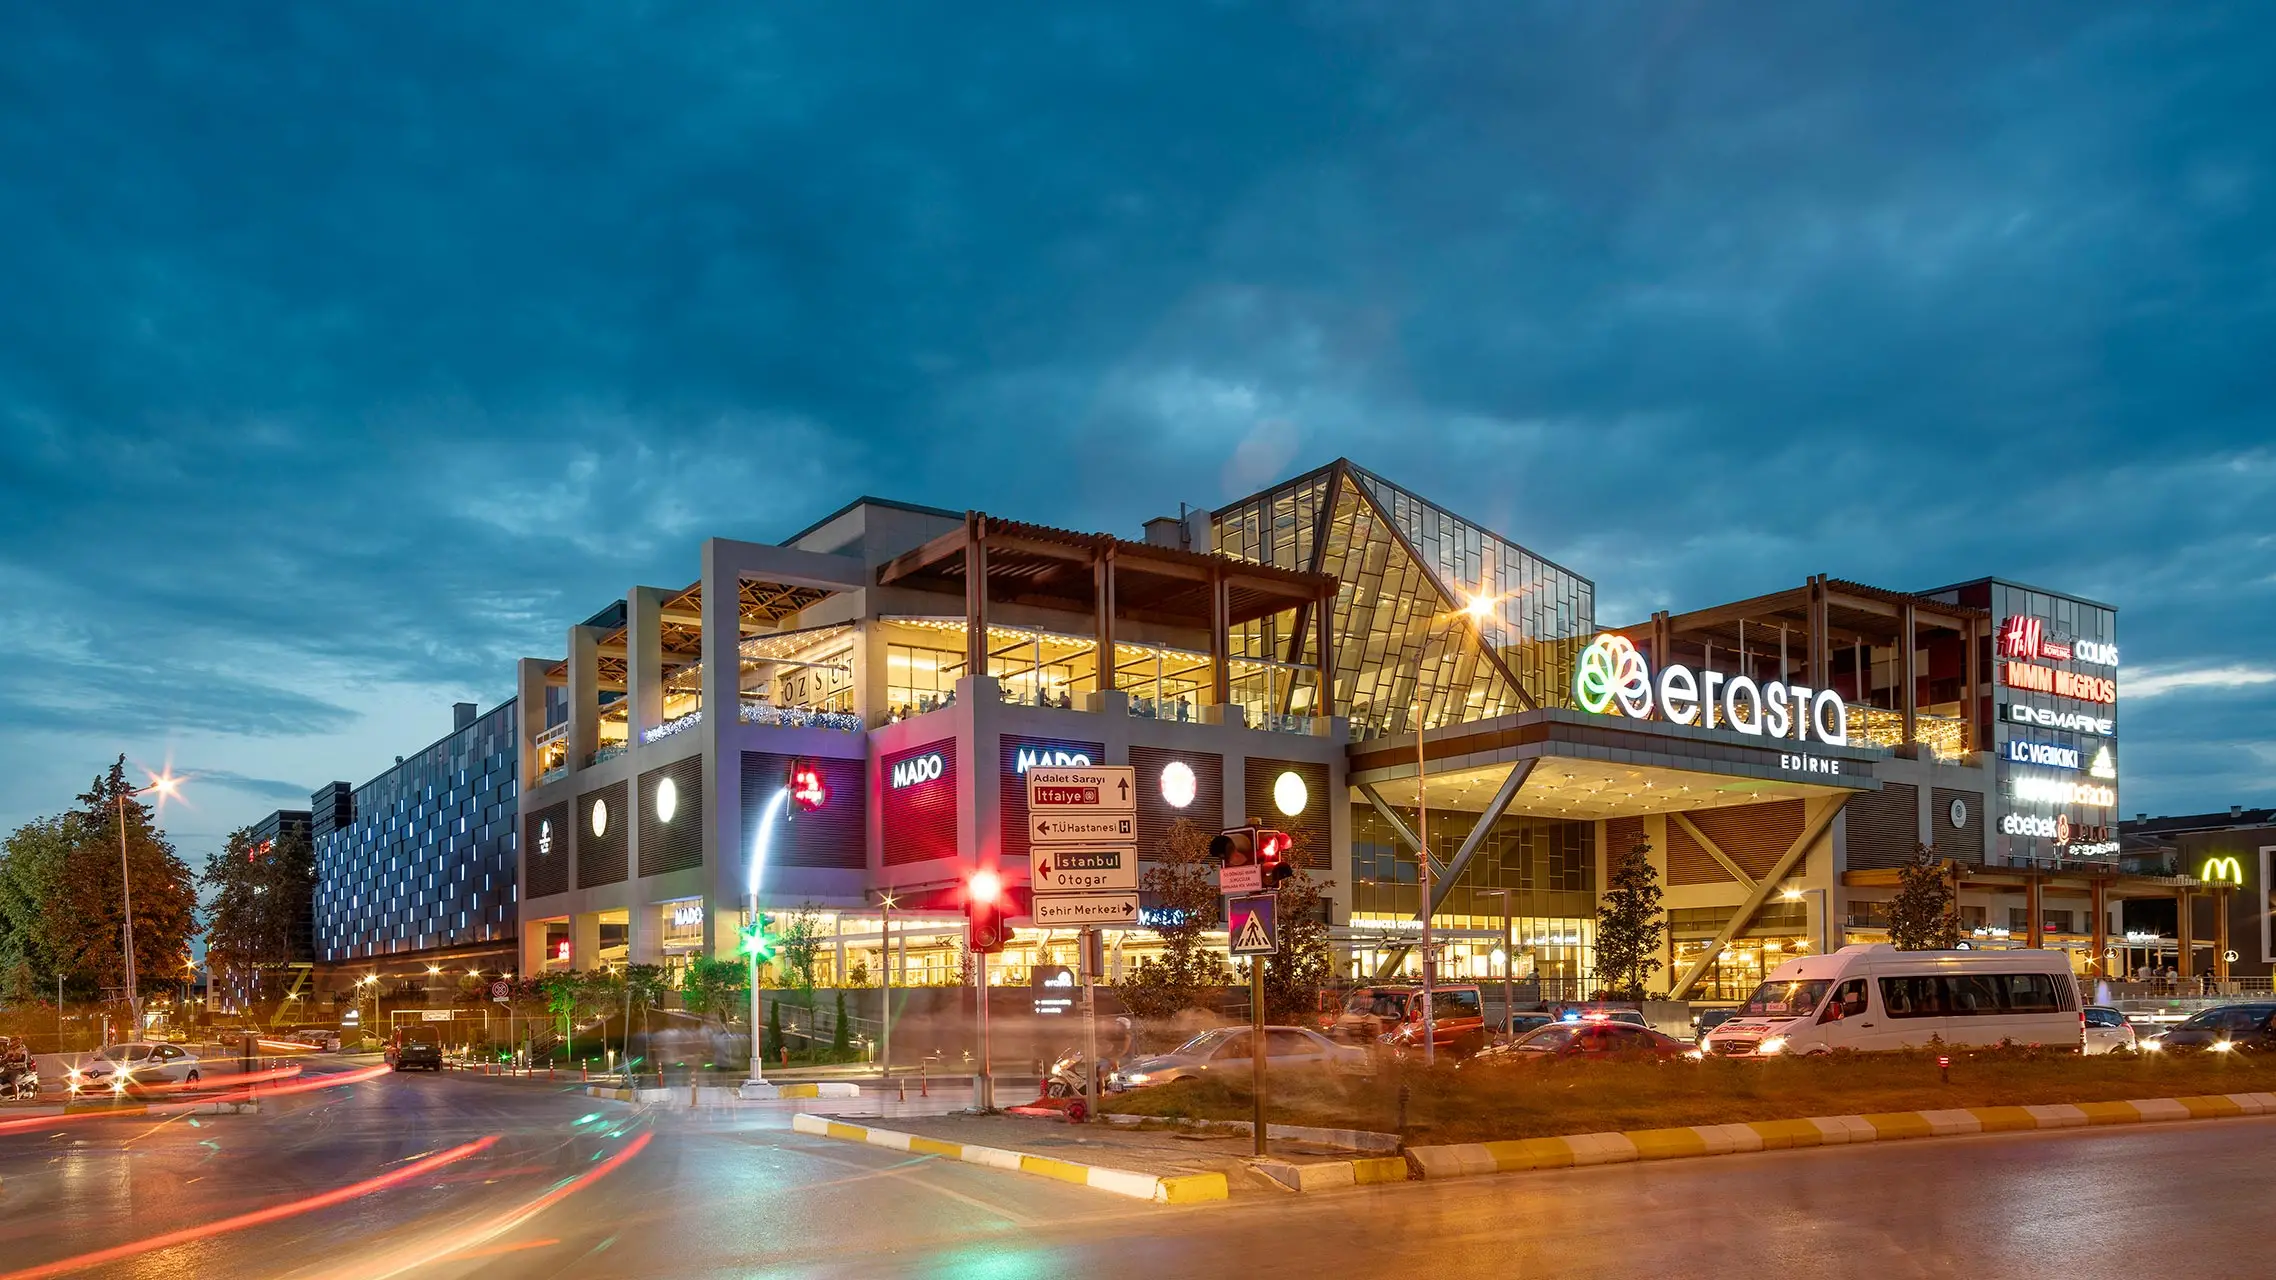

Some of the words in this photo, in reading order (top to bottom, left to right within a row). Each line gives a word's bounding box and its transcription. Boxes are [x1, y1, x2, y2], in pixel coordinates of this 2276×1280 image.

[2006, 615, 2041, 660] H&M
[2008, 660, 2053, 692] MMM
[2011, 740, 2029, 761] LC
[893, 754, 942, 789] MADO
[1781, 752, 1840, 775] EDİRNE
[1033, 774, 1069, 783] Adalet
[1072, 774, 1105, 785] Sarayı
[1037, 787, 1081, 804] İtfaiye
[2003, 812, 2057, 838] ebebek
[1056, 853, 1118, 867] İstanbul
[1057, 873, 1107, 887] Otogar
[674, 906, 703, 926] MADO
[1040, 906, 1072, 917] Şehir
[1074, 904, 1121, 915] Merkezi
